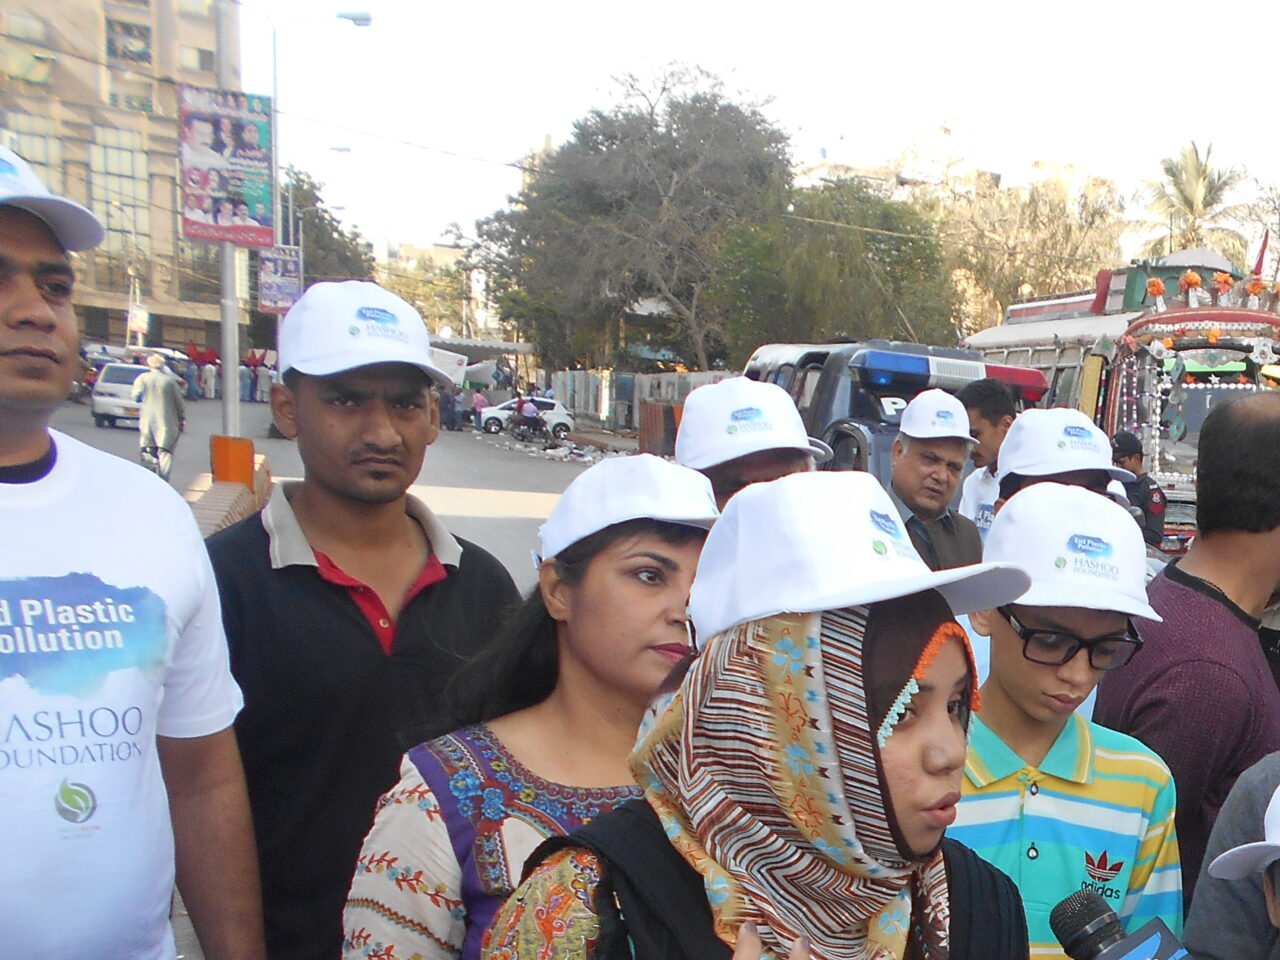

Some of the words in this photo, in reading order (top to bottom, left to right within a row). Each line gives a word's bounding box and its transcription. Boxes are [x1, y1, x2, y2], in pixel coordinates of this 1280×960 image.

[1074, 557, 1119, 576] HASHOO
[20, 597, 135, 626] Plastic
[0, 625, 124, 653] ollution
[0, 706, 143, 743] ASHOO
[0, 740, 143, 770] OUNDATION
[1081, 879, 1121, 899] adidas
